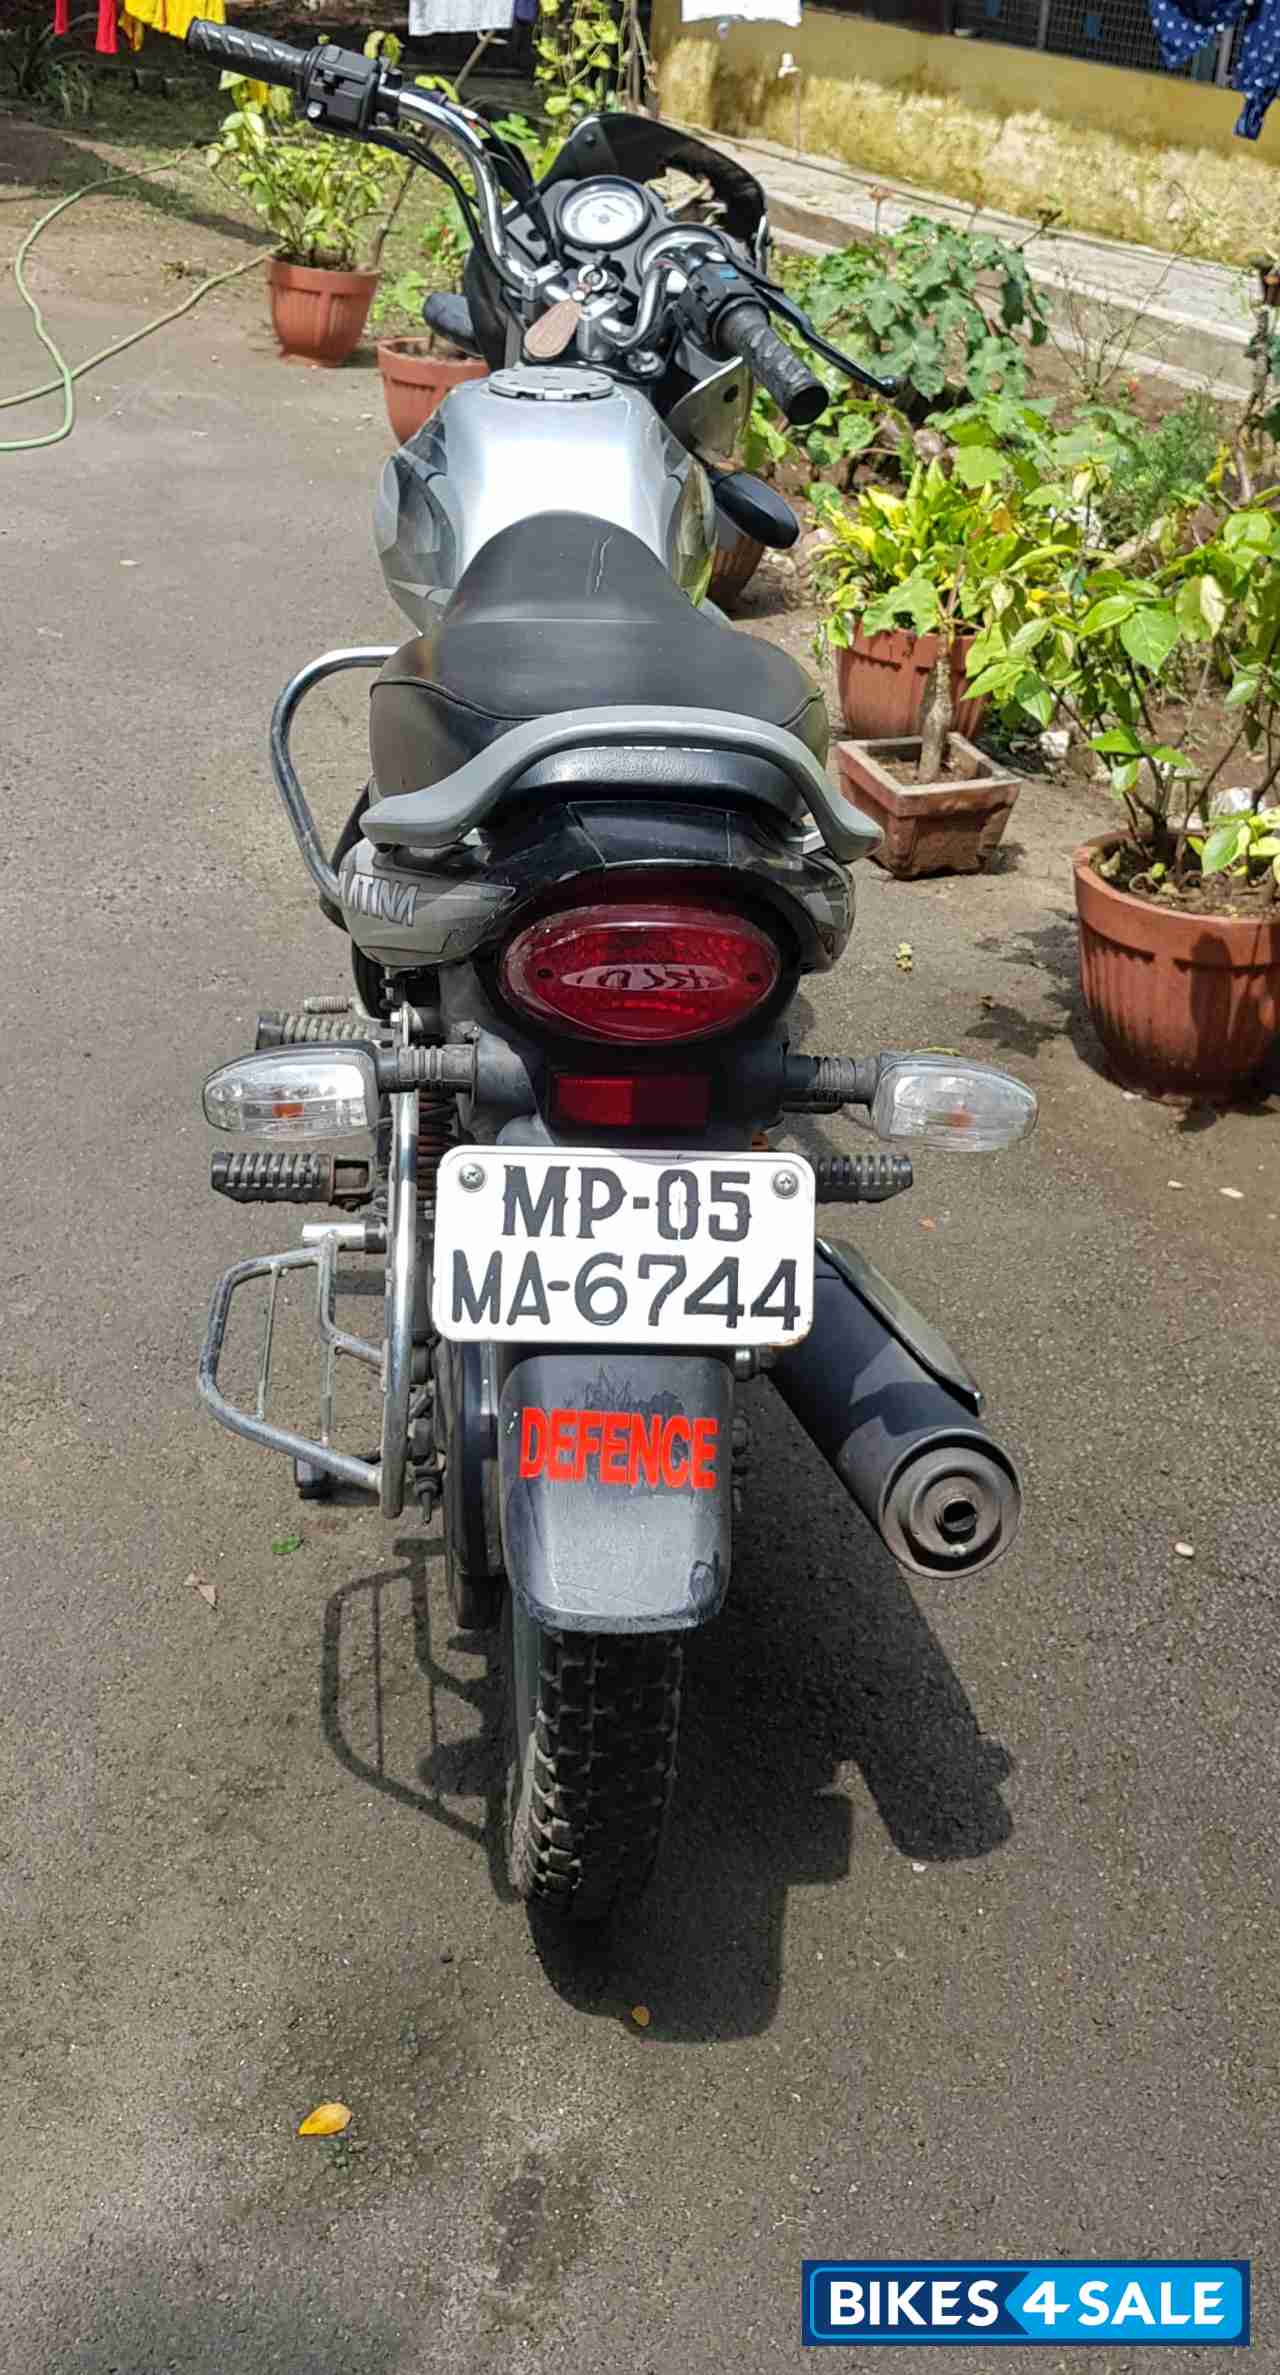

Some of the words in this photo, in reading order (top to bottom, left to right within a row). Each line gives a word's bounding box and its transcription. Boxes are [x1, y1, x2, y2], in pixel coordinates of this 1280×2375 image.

[501, 1164, 752, 1242] MP-05
[451, 1249, 801, 1330] MA-6744
[518, 1407, 719, 1489] DEFENCE
